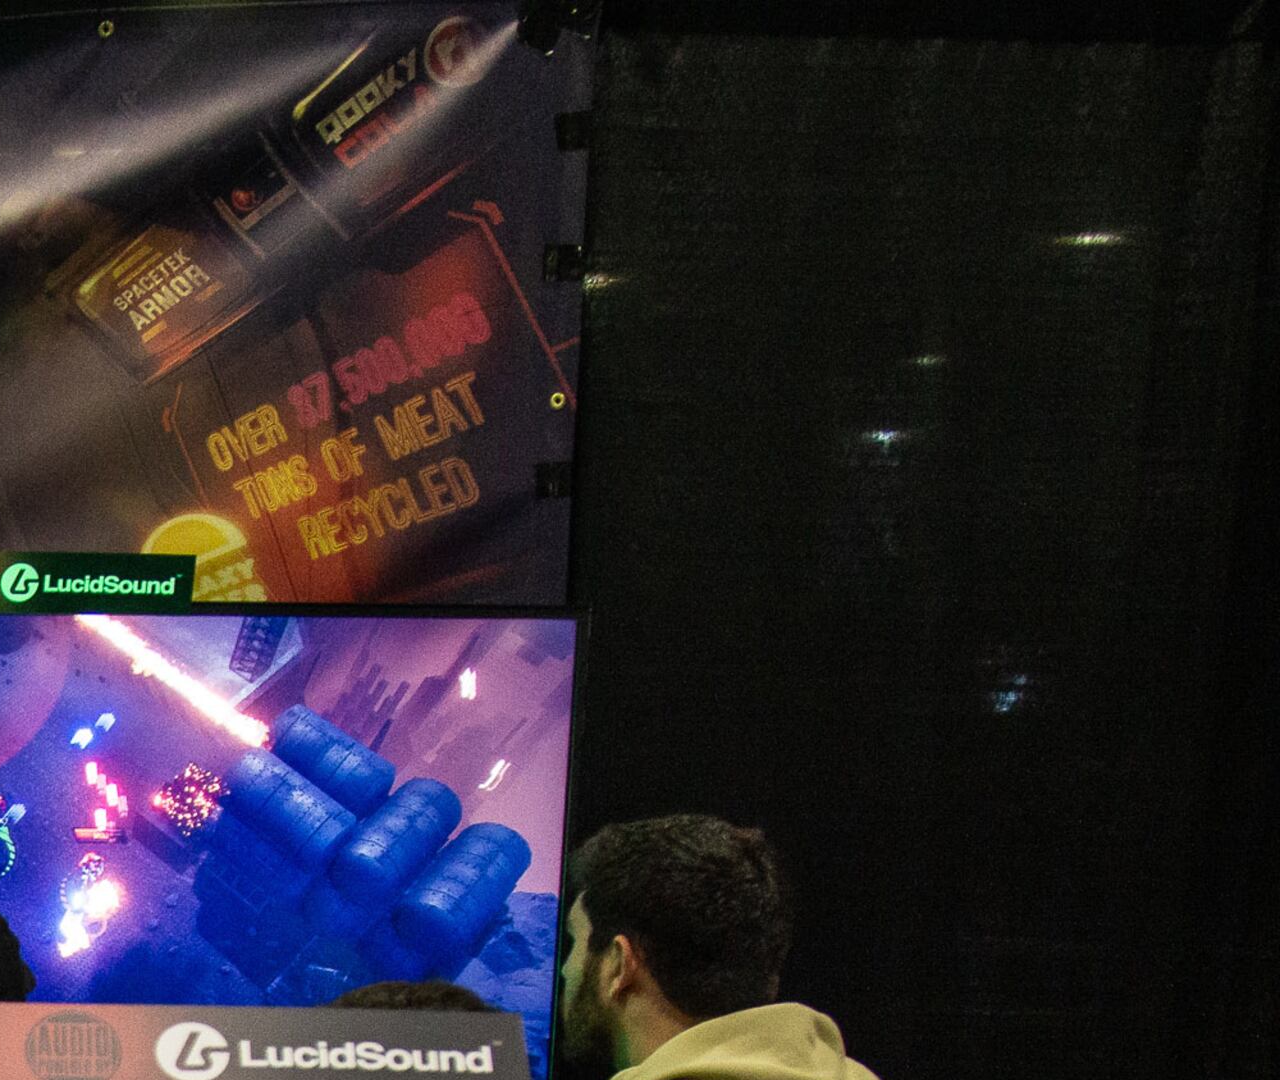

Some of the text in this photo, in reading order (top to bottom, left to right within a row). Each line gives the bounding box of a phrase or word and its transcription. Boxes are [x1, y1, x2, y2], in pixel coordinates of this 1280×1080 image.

[113, 247, 191, 311] SPACETEK
[128, 264, 211, 331] ARMOR
[207, 403, 289, 472] OVER
[233, 370, 486, 520] TONS OF MEAT
[296, 456, 480, 561] RECYCLED
[43, 573, 176, 595] LucidSound
[37, 1023, 494, 1074] AUDIO LucidSound
